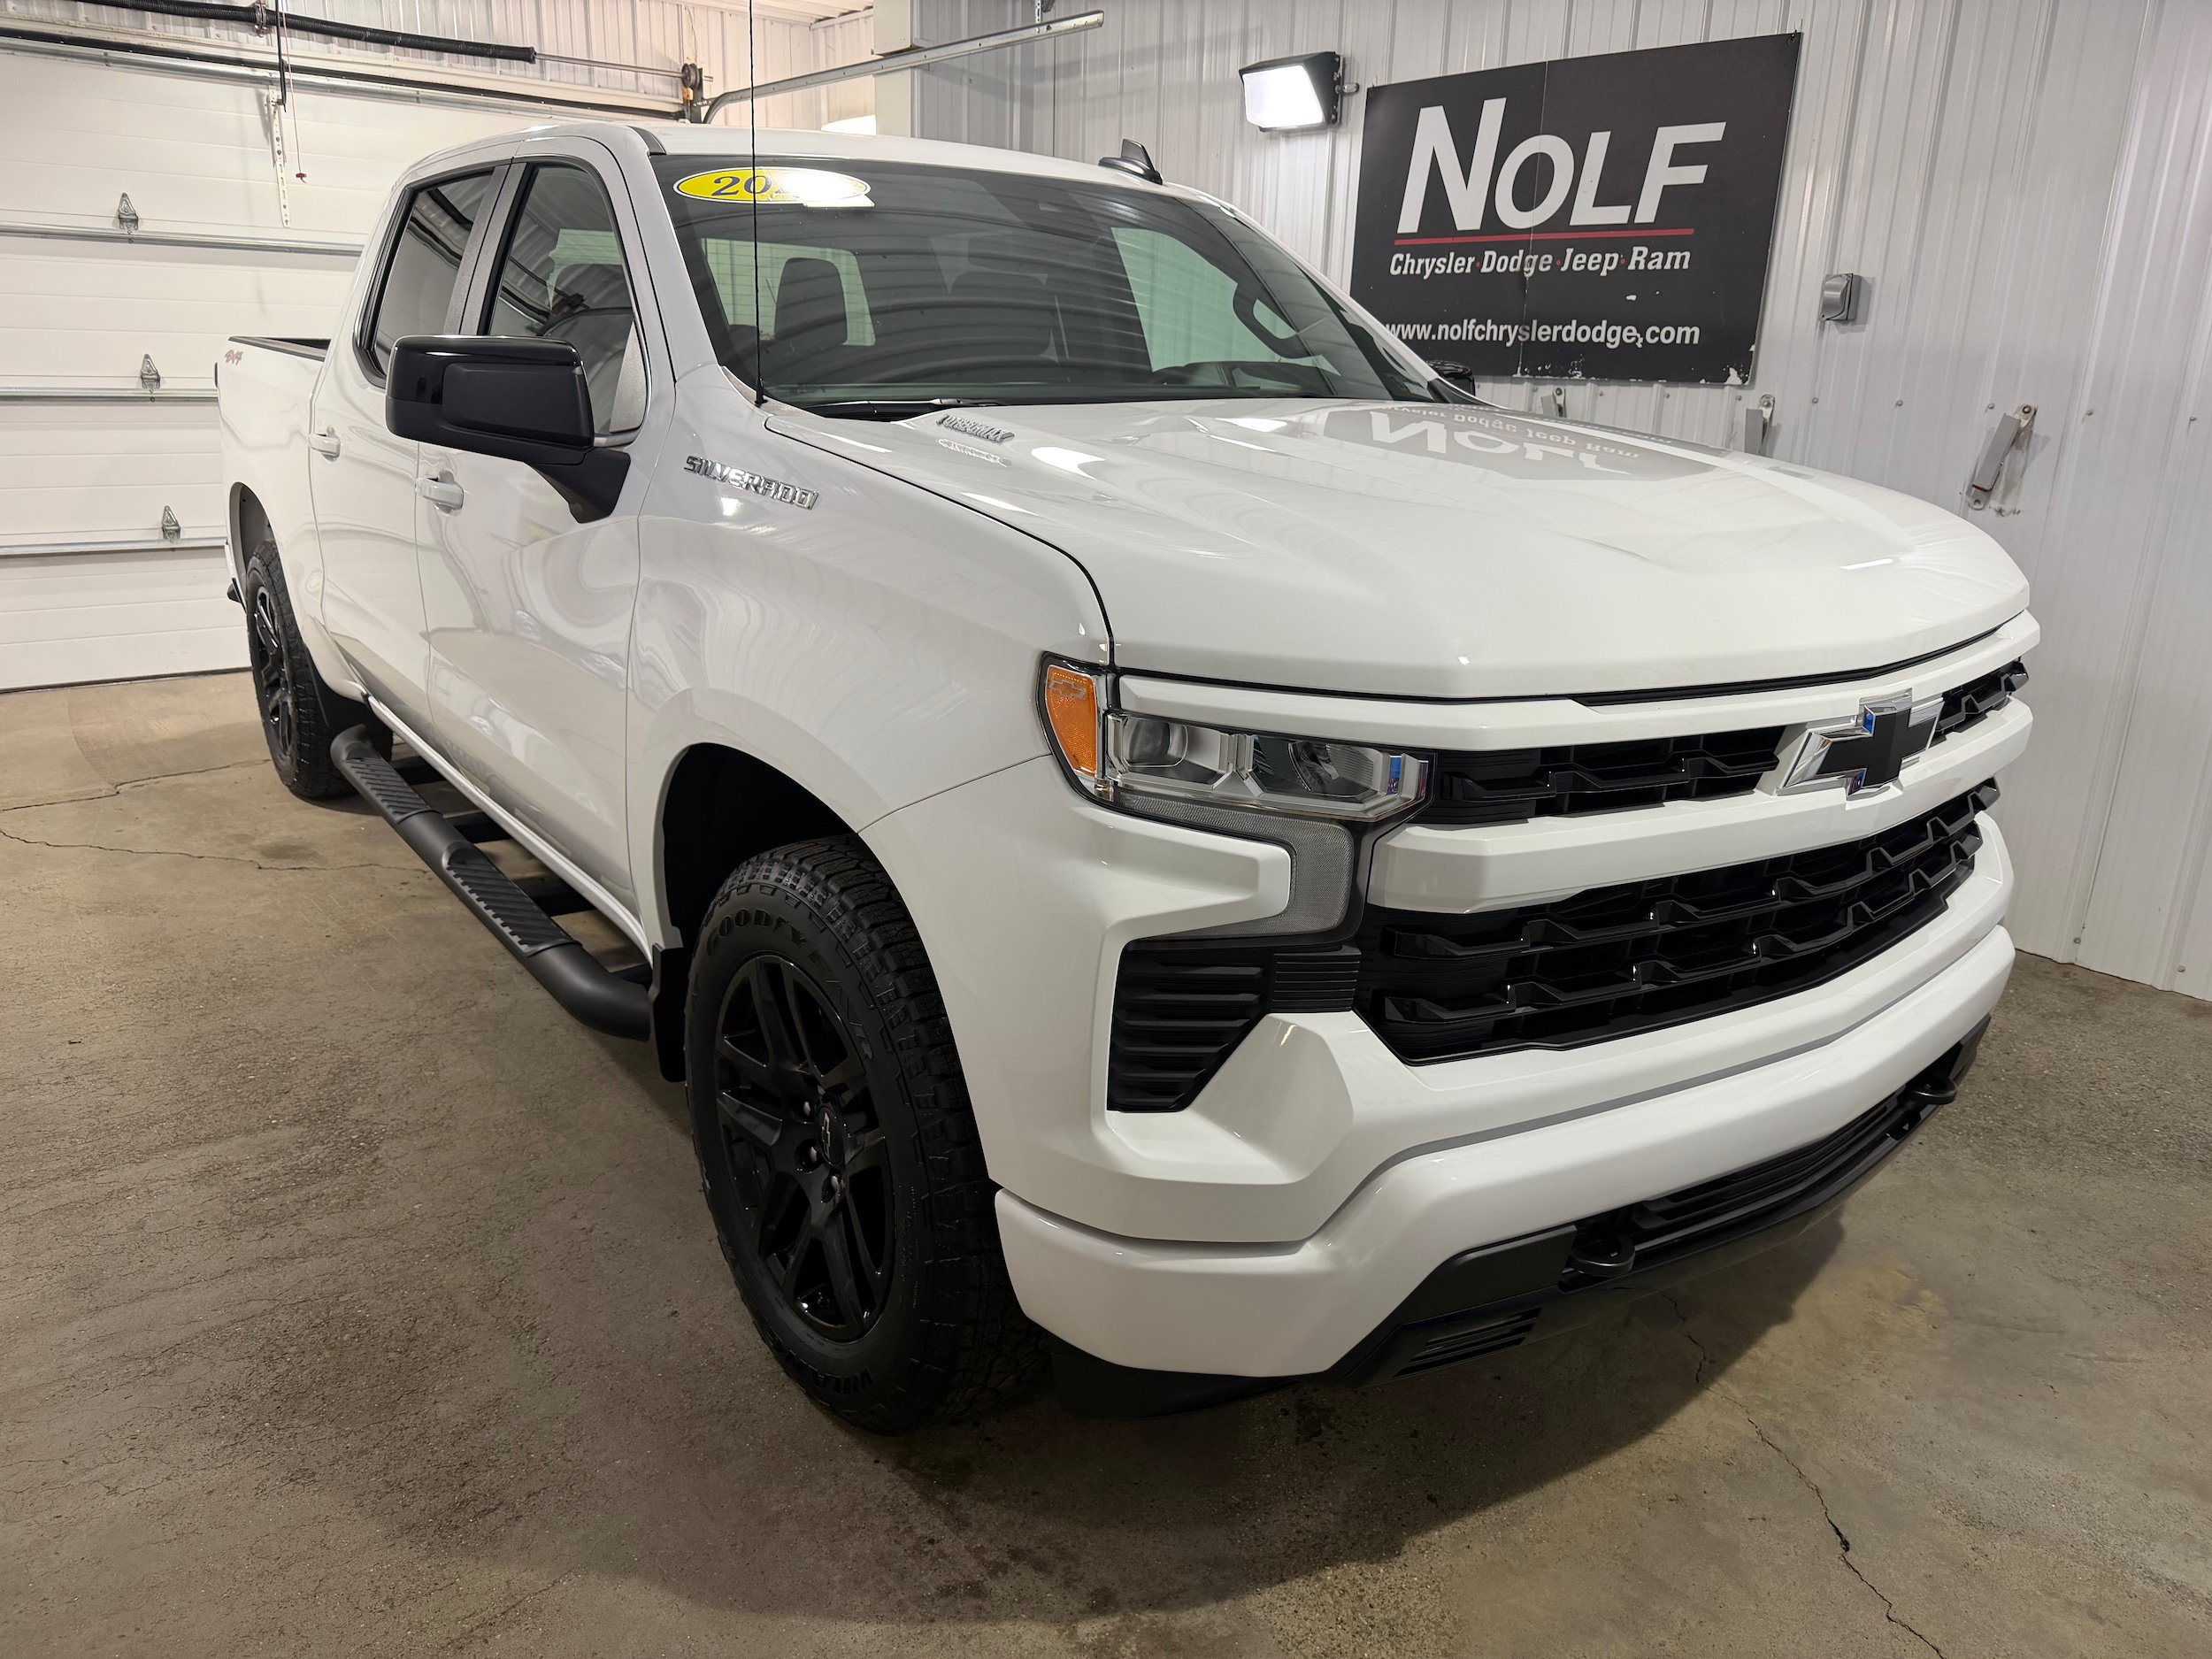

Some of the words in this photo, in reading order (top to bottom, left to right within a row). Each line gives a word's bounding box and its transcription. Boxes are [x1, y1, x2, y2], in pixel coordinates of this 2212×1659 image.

[1396, 97, 1726, 234] NOLF
[1389, 252, 1475, 280] Chrysler
[1480, 249, 1553, 277] Dodge
[1560, 247, 1619, 277] Jeep
[1628, 246, 1691, 271] Ram
[683, 455, 819, 511] SILVERADO
